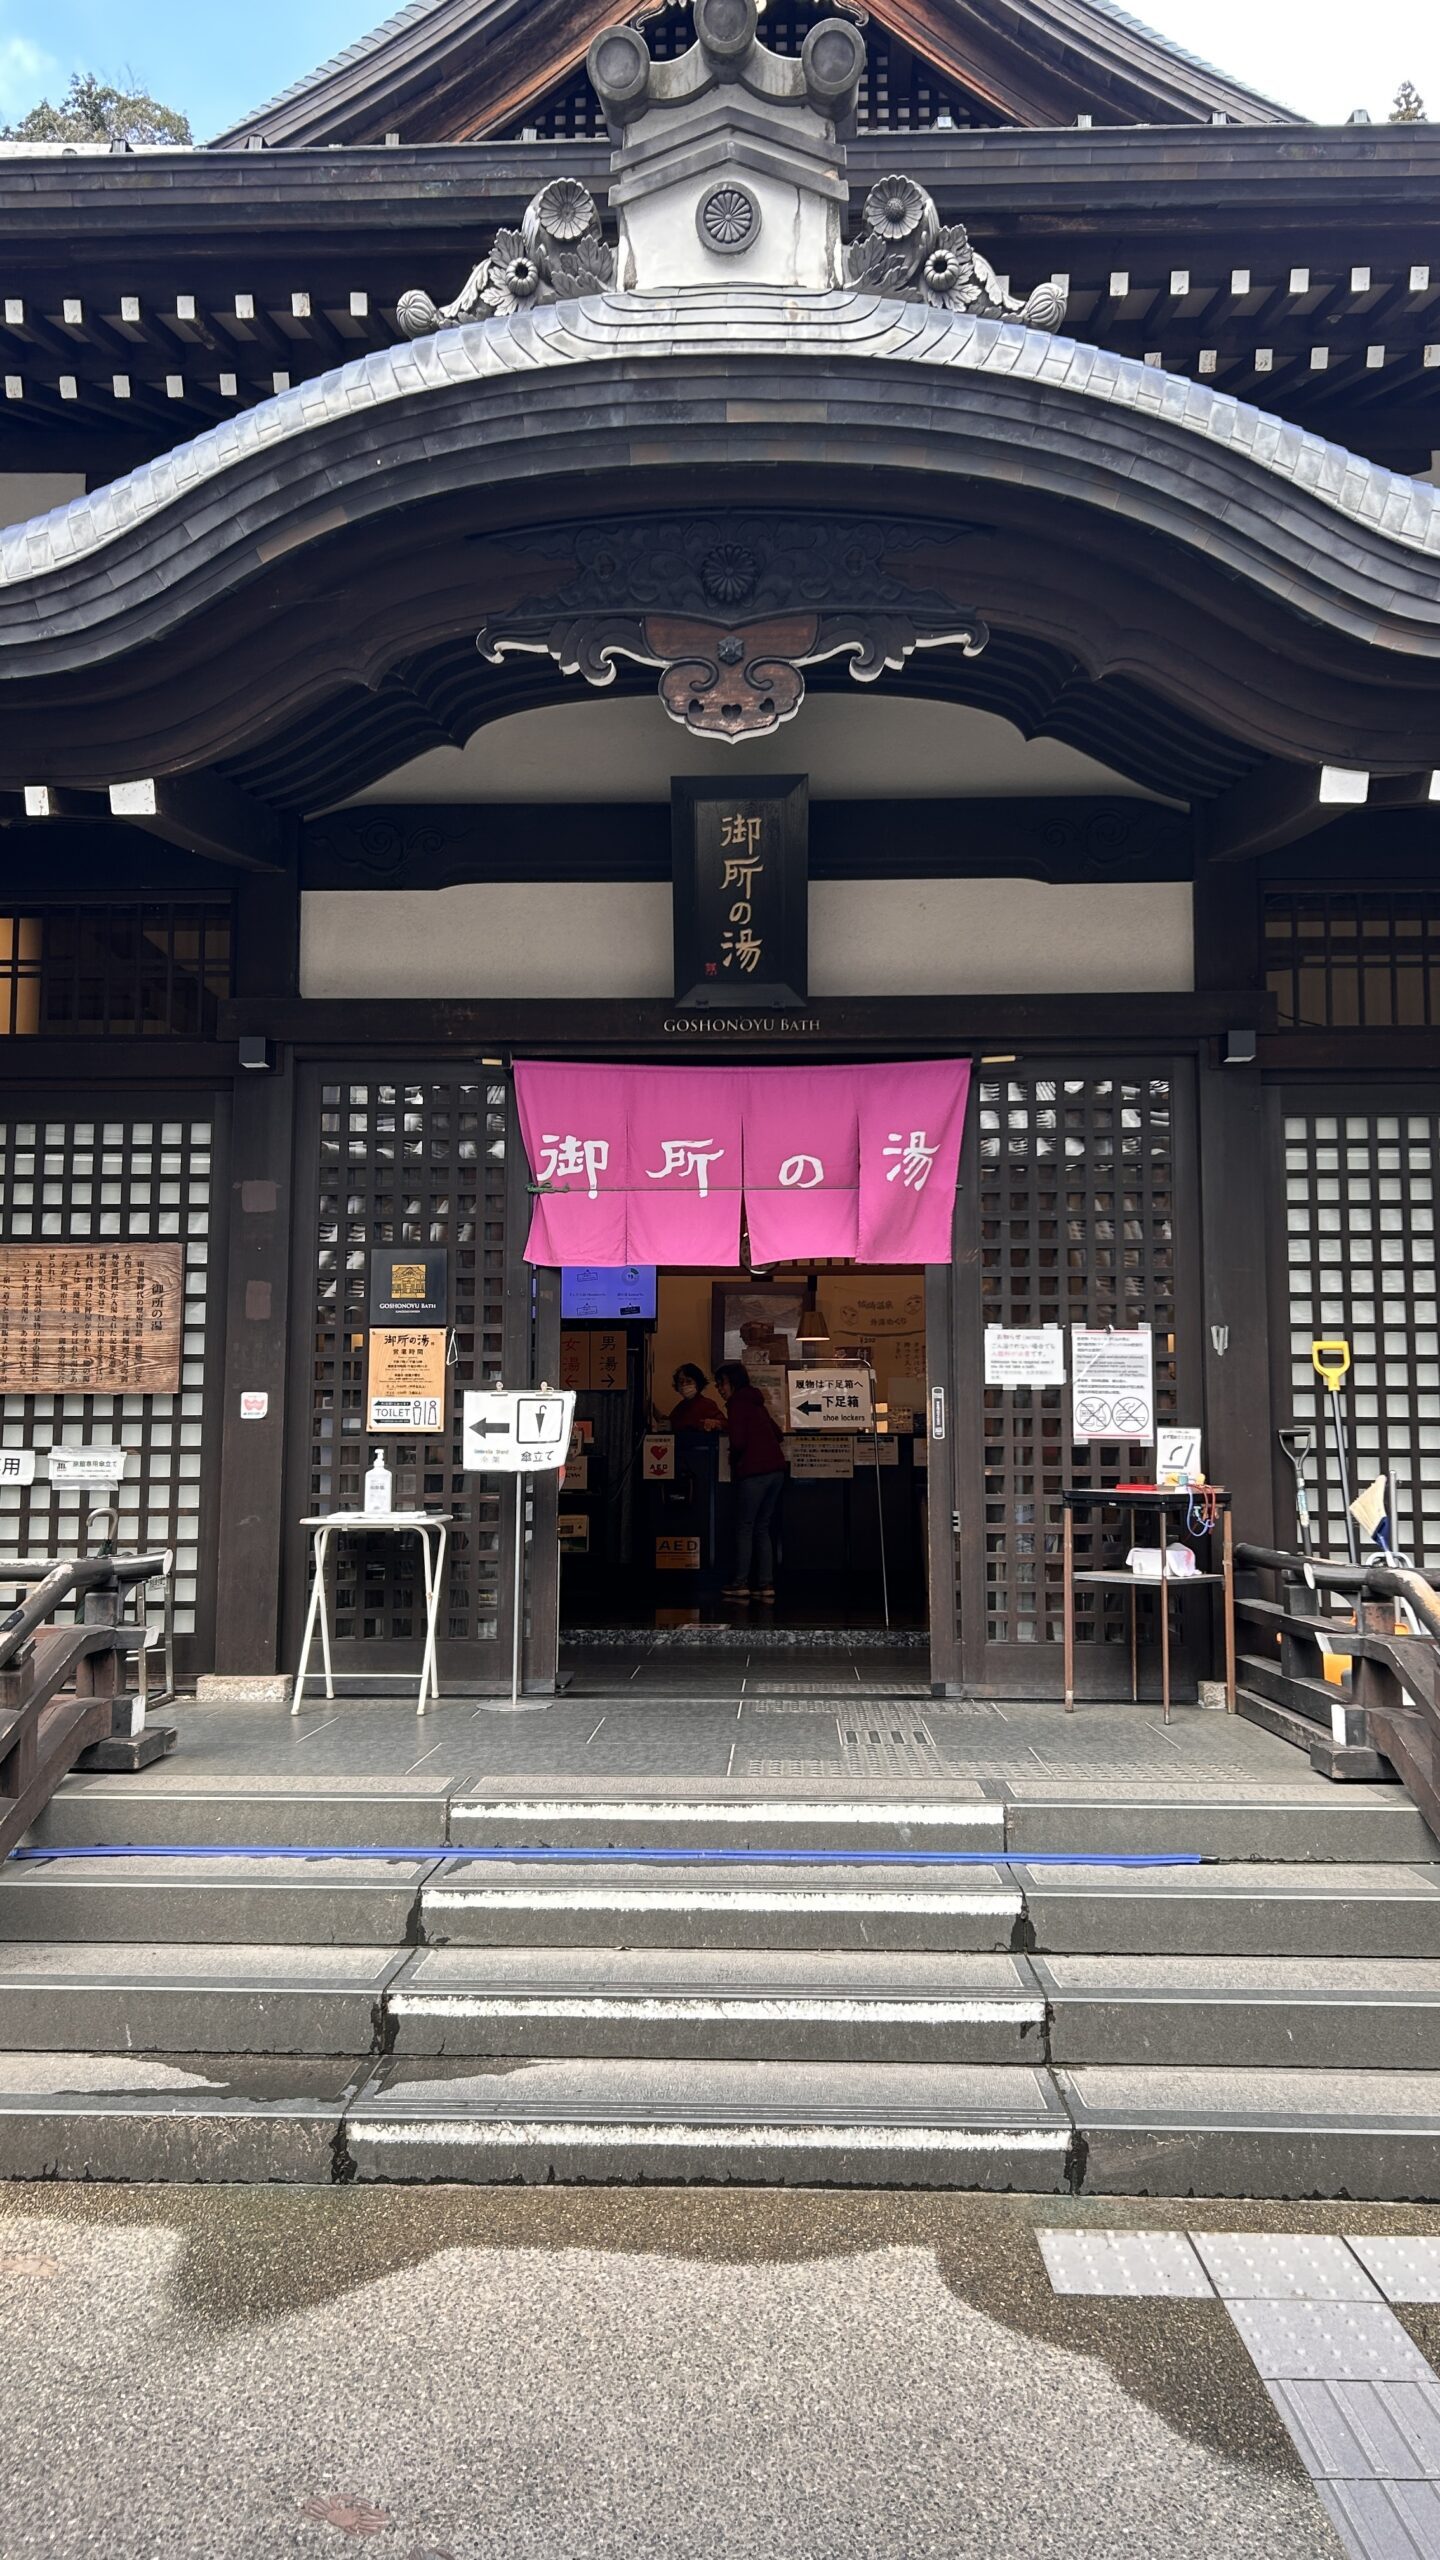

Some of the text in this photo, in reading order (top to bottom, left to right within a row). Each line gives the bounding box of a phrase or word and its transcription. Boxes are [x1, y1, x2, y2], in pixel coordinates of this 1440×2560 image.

[720, 813, 763, 973] 御所の湯
[663, 1018, 820, 1032] GOSHONOYU BATH
[537, 1131, 940, 1199] 御所の湯
[151, 1284, 164, 1332] 御所の湯
[384, 1334, 430, 1347] 御所の湯
[600, 1336, 618, 1372] 男湯
[796, 1380, 864, 1389] 履物は下足箱へ
[822, 1396, 859, 1408] 下足箱
[376, 1408, 410, 1417] TOILET
[521, 1451, 554, 1462] 傘立て
[658, 1541, 697, 1551] AED
